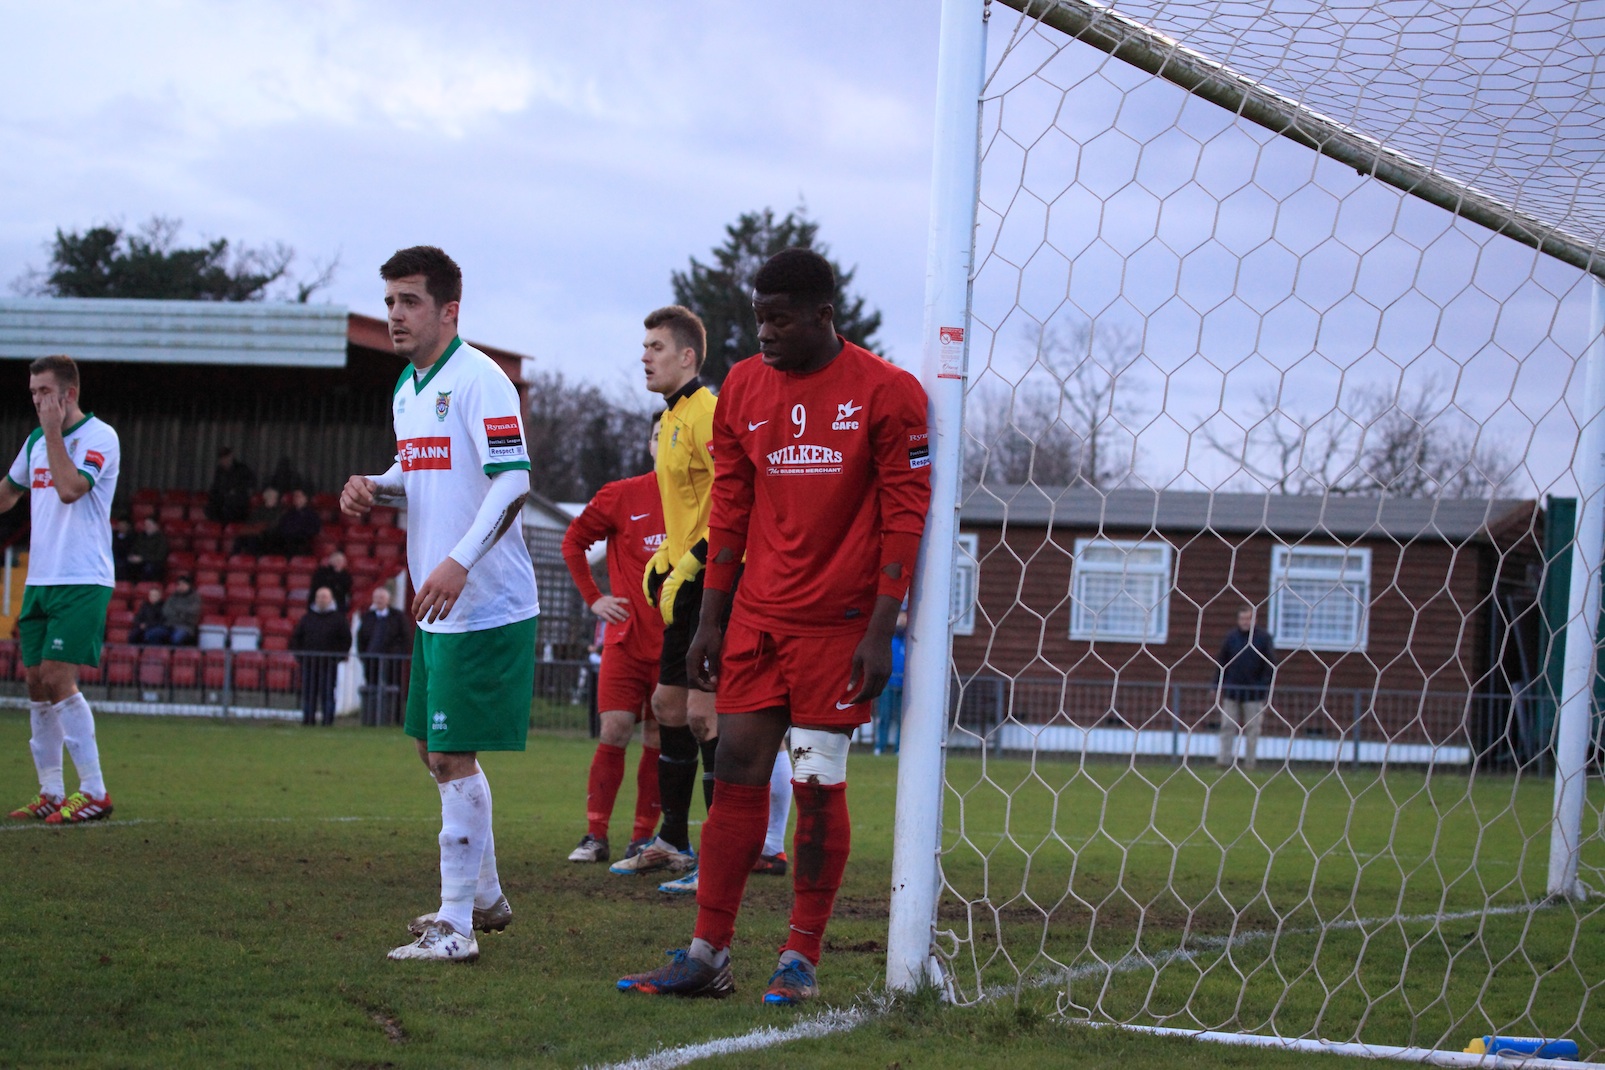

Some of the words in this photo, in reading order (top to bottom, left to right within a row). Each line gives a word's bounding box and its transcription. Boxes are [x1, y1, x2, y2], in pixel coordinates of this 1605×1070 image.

[791, 403, 806, 438] 9
[486, 423, 517, 431] Ryman
[832, 421, 859, 431] CAFC
